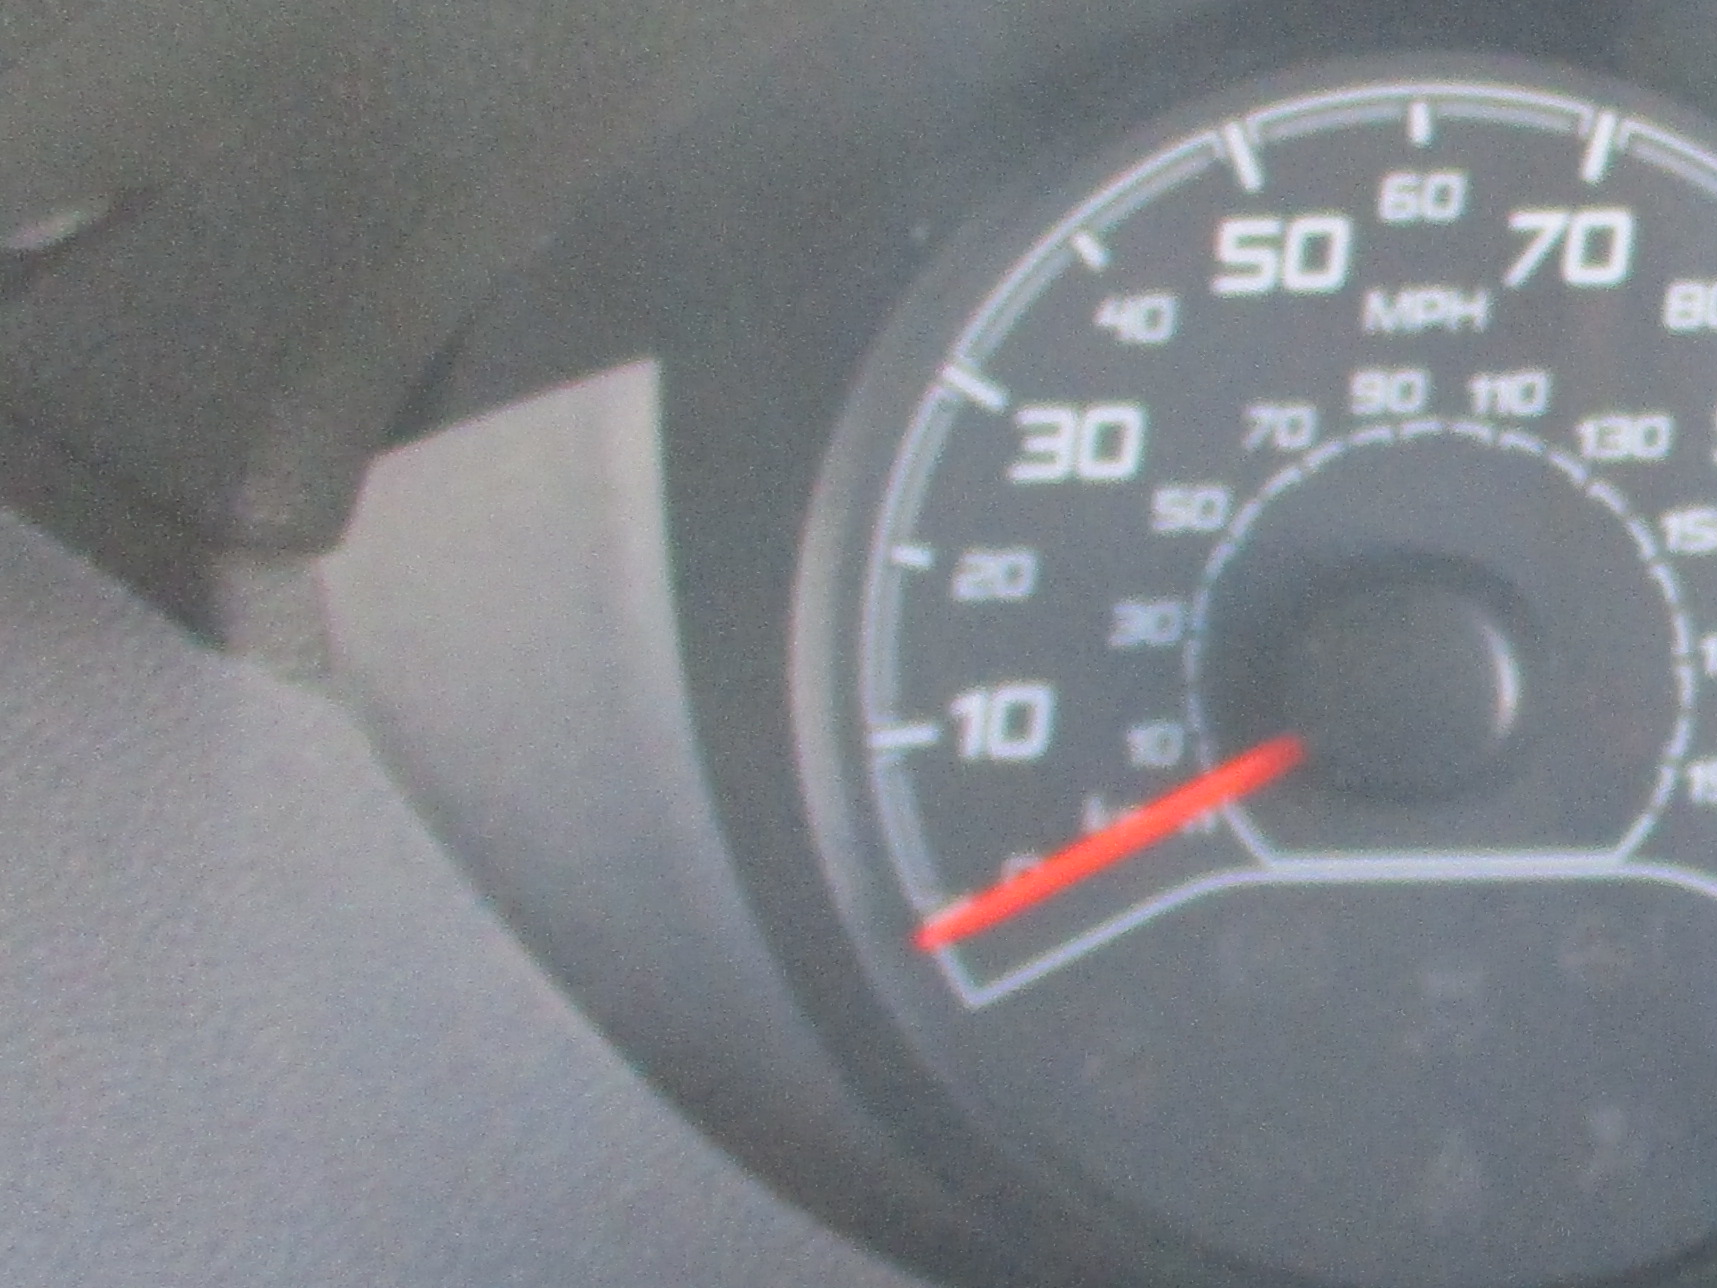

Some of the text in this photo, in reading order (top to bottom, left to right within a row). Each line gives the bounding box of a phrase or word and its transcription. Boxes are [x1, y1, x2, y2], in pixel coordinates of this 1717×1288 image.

[1381, 174, 1463, 219] 60
[1215, 218, 1351, 288] 50
[1506, 214, 1631, 284] 70
[1098, 296, 1174, 340] 40
[1365, 294, 1488, 329] MPH
[1351, 373, 1424, 412] 90
[1470, 374, 1549, 414] 110
[1013, 409, 1143, 479] 30
[1244, 408, 1316, 449] 70
[1579, 416, 1670, 457] 130
[1152, 489, 1231, 531] 50
[952, 553, 1036, 598] 20
[951, 687, 1051, 759] 10
